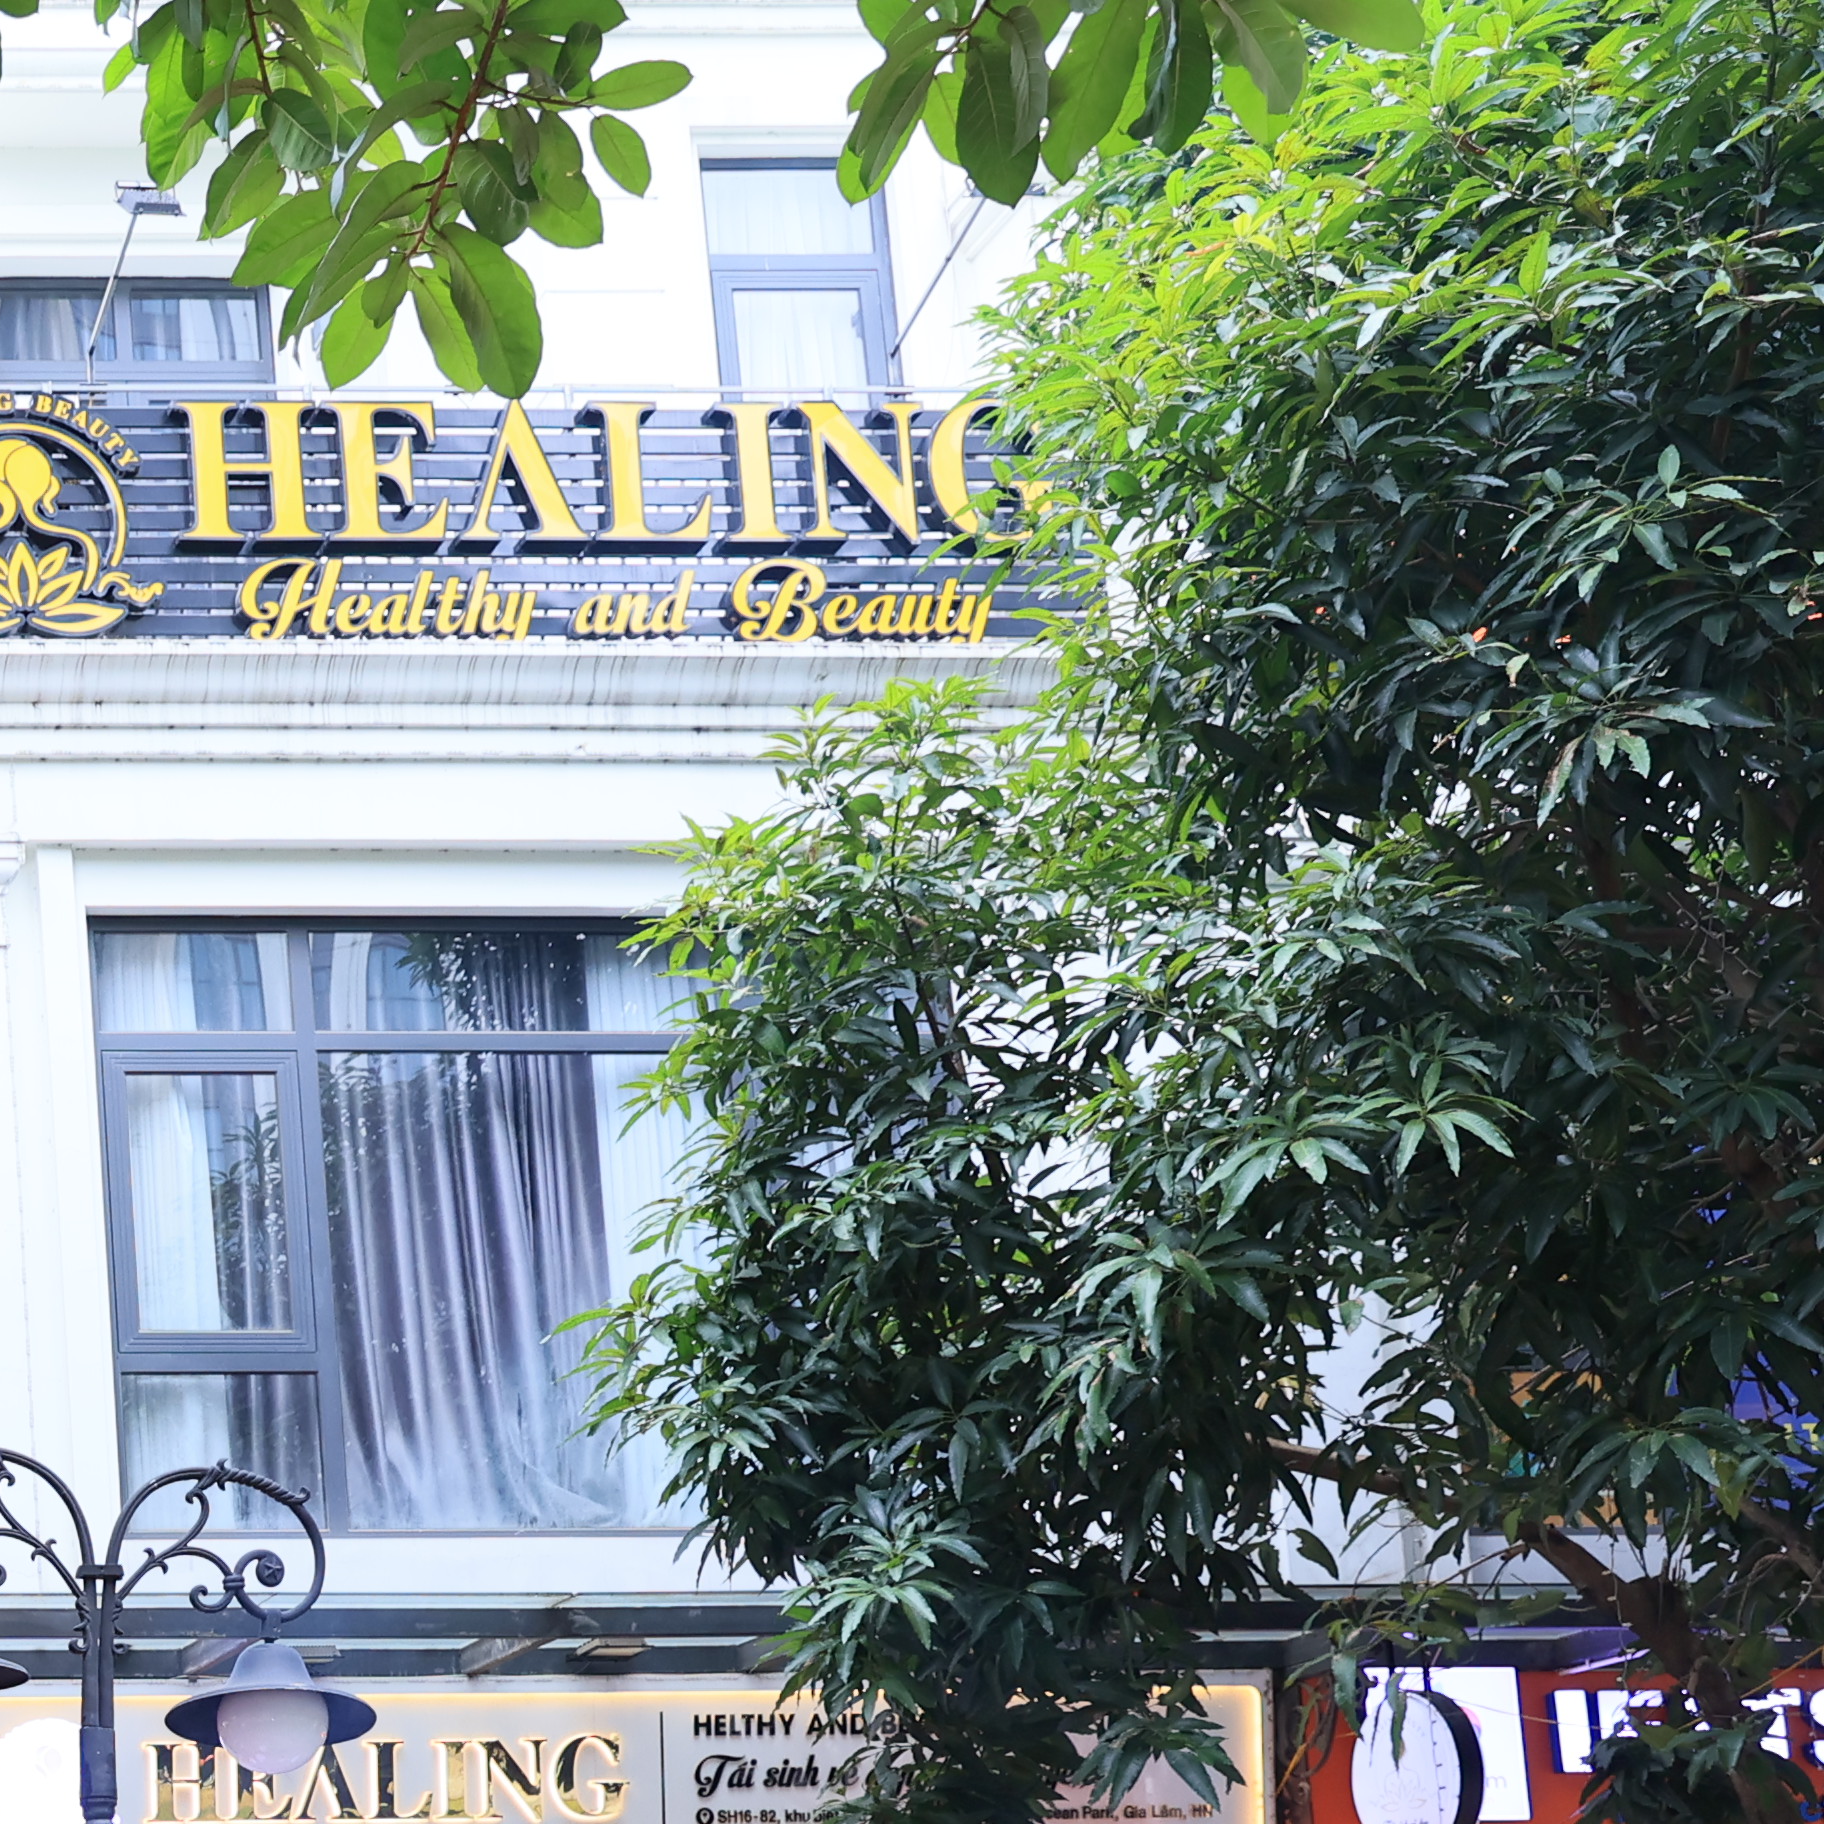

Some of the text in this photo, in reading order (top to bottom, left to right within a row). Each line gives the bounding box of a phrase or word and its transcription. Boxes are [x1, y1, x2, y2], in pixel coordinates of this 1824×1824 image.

[34, 393, 142, 468] BEAUTY
[240, 555, 993, 643] Healthy and Beauty
[693, 1714, 795, 1737] HELTHY
[763, 1754, 820, 1788] sinh
[717, 1809, 781, 1824] SH16-82,
